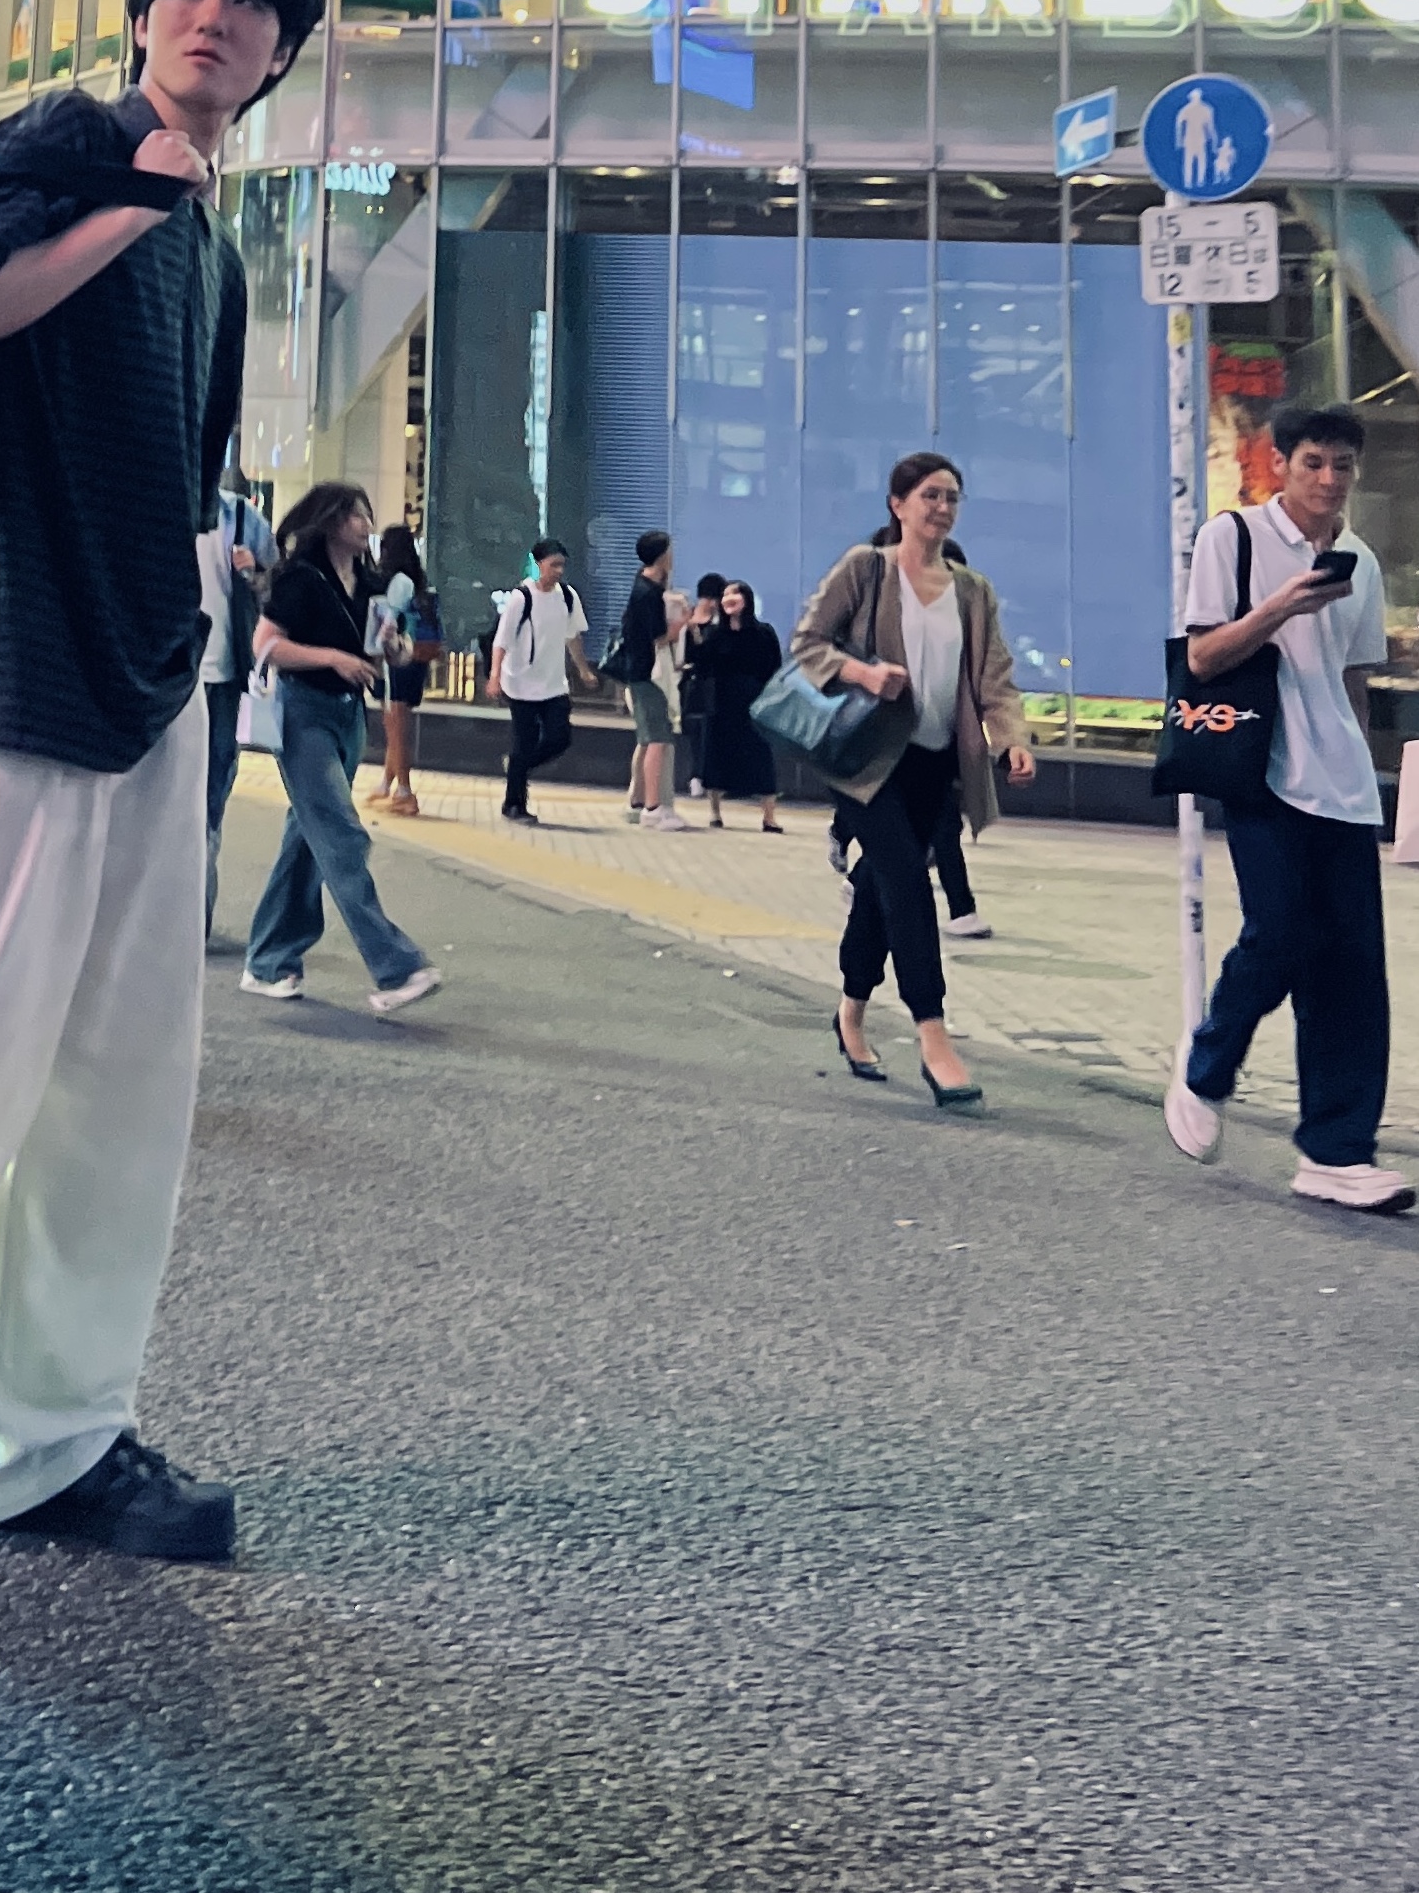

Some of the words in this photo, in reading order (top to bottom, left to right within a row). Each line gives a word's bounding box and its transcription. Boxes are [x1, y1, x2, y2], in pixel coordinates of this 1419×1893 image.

[1157, 214, 1182, 239] 15
[1244, 210, 1260, 235] 5
[1158, 272, 1183, 297] 12
